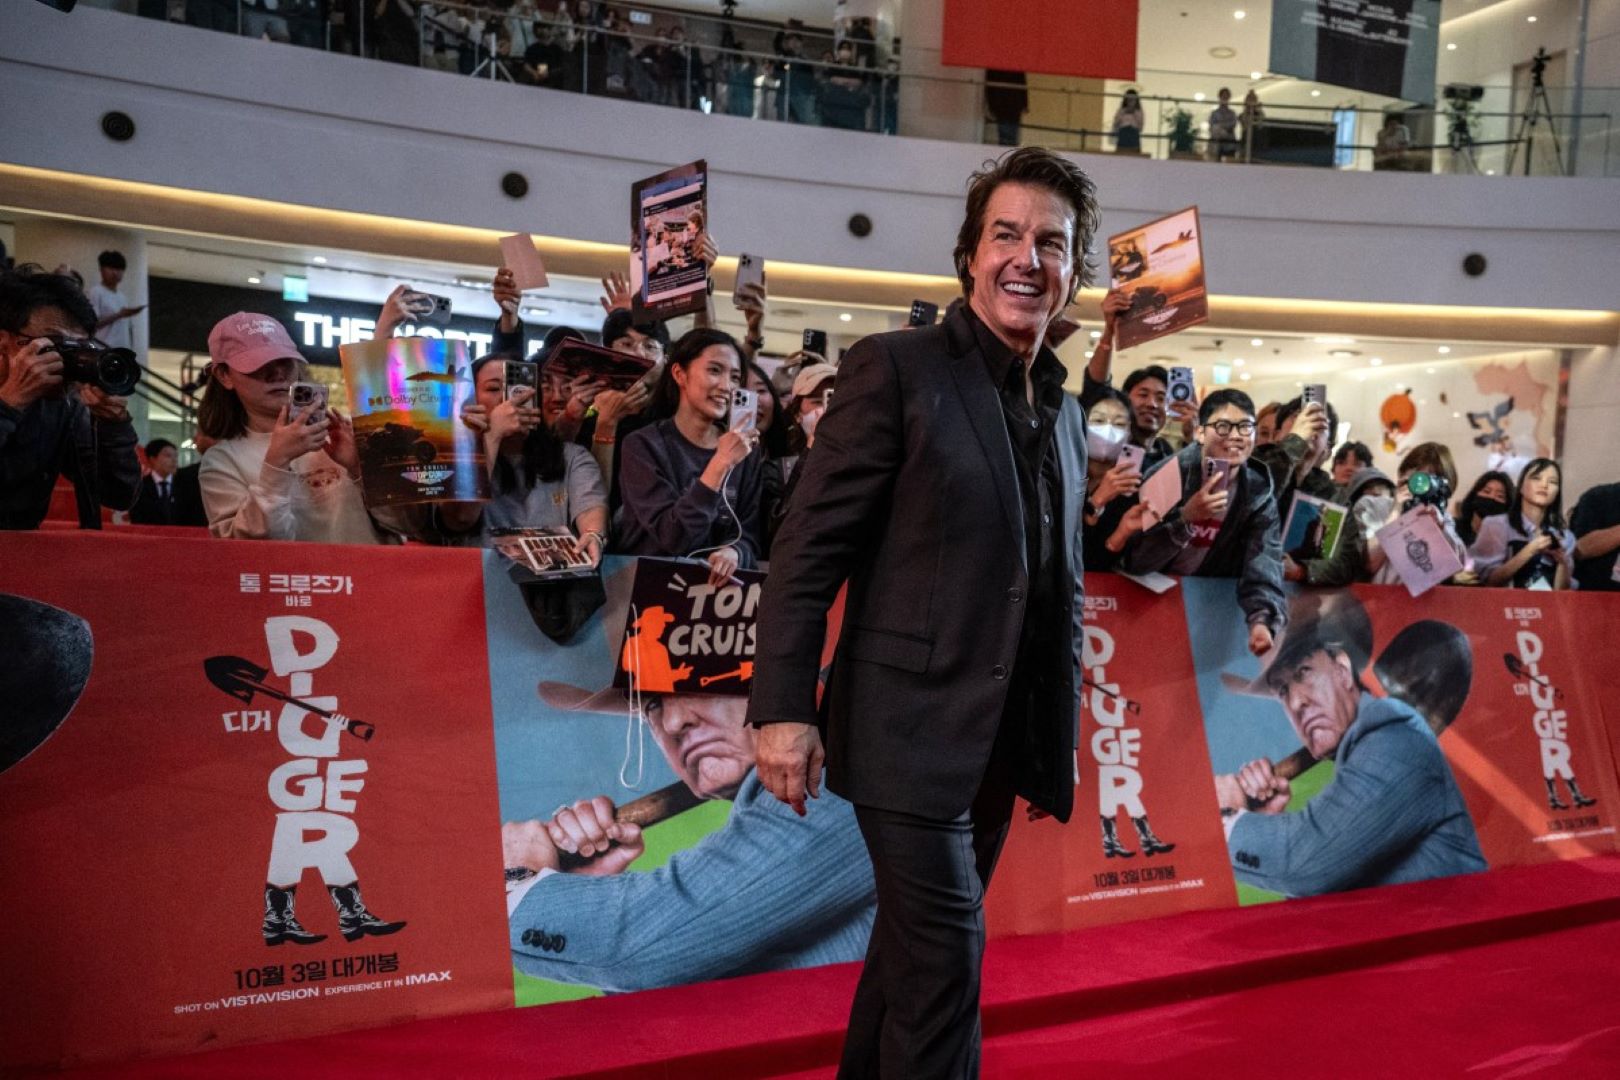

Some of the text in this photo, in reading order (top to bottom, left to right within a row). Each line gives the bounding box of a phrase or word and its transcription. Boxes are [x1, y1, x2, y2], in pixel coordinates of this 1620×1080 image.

[294, 312, 376, 348] THE
[384, 394, 416, 406] Dolby
[240, 573, 354, 595] 톰 크루즈가
[285, 595, 312, 607] 바로
[222, 710, 271, 732] 디거
[234, 952, 399, 990] 10월 3일 대개봉
[174, 970, 452, 1014] SHOT ON VISTAVISION EXPERIENCE IT IN IMAX
